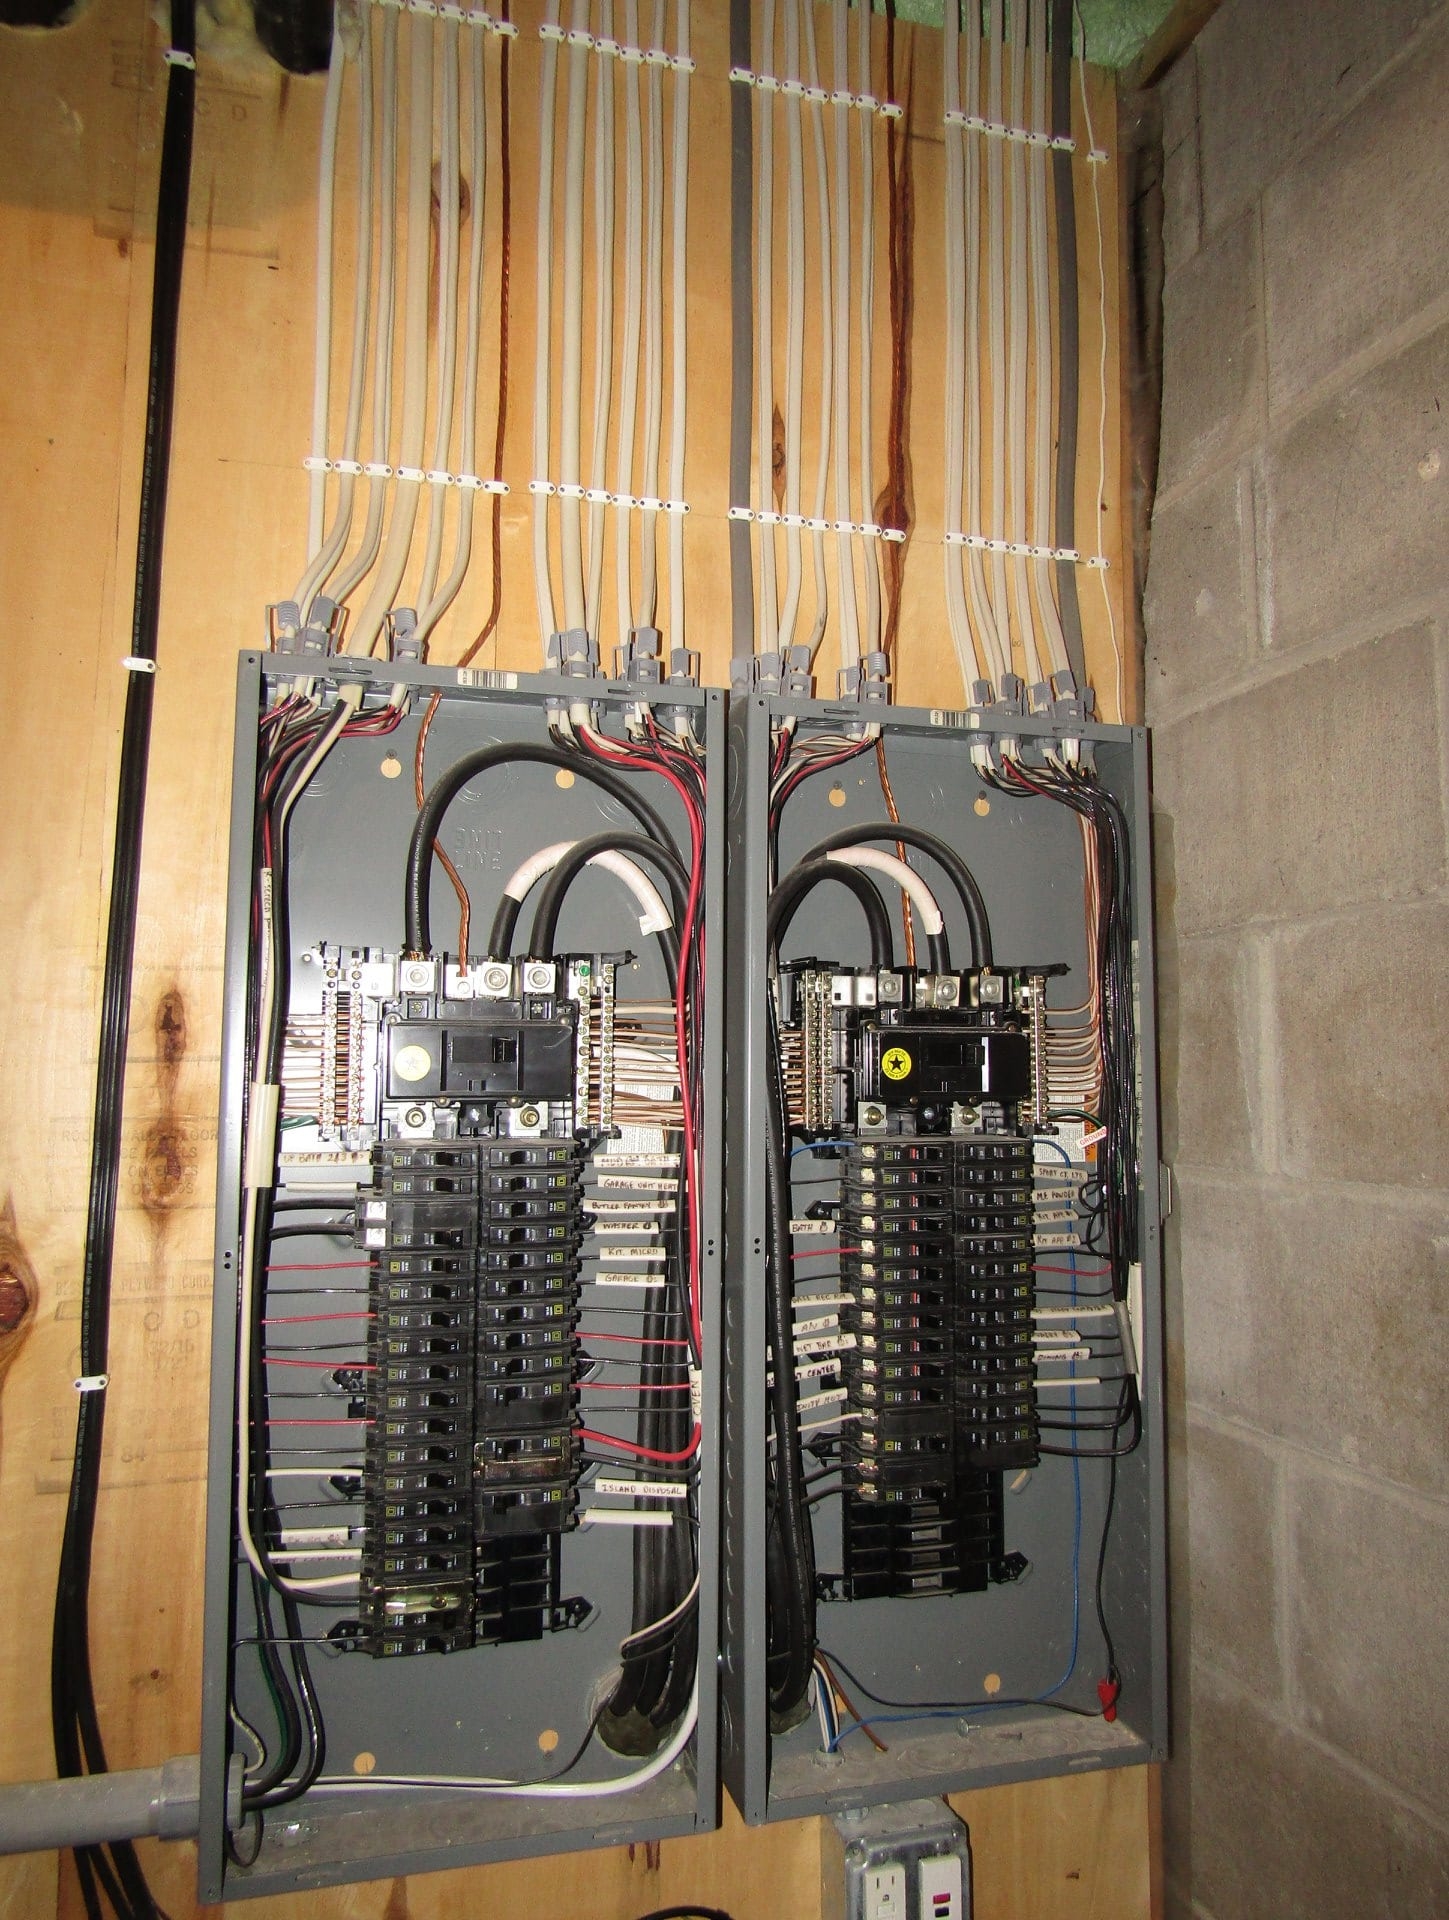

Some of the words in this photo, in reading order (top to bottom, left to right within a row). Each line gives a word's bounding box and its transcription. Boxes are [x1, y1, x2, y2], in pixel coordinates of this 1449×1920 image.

[1078, 1127, 1107, 1146] GROUND
[603, 1178, 634, 1190] GARAGE
[592, 1201, 619, 1210] BUTLER
[602, 1222, 639, 1230] WASHER
[792, 1223, 813, 1233] BATH
[630, 1247, 658, 1256] MICRO
[807, 1363, 835, 1378] CENTER
[690, 1380, 702, 1416] OVEN
[601, 1483, 636, 1493] ISLAND
[643, 1486, 682, 1495] DISPOSAL
